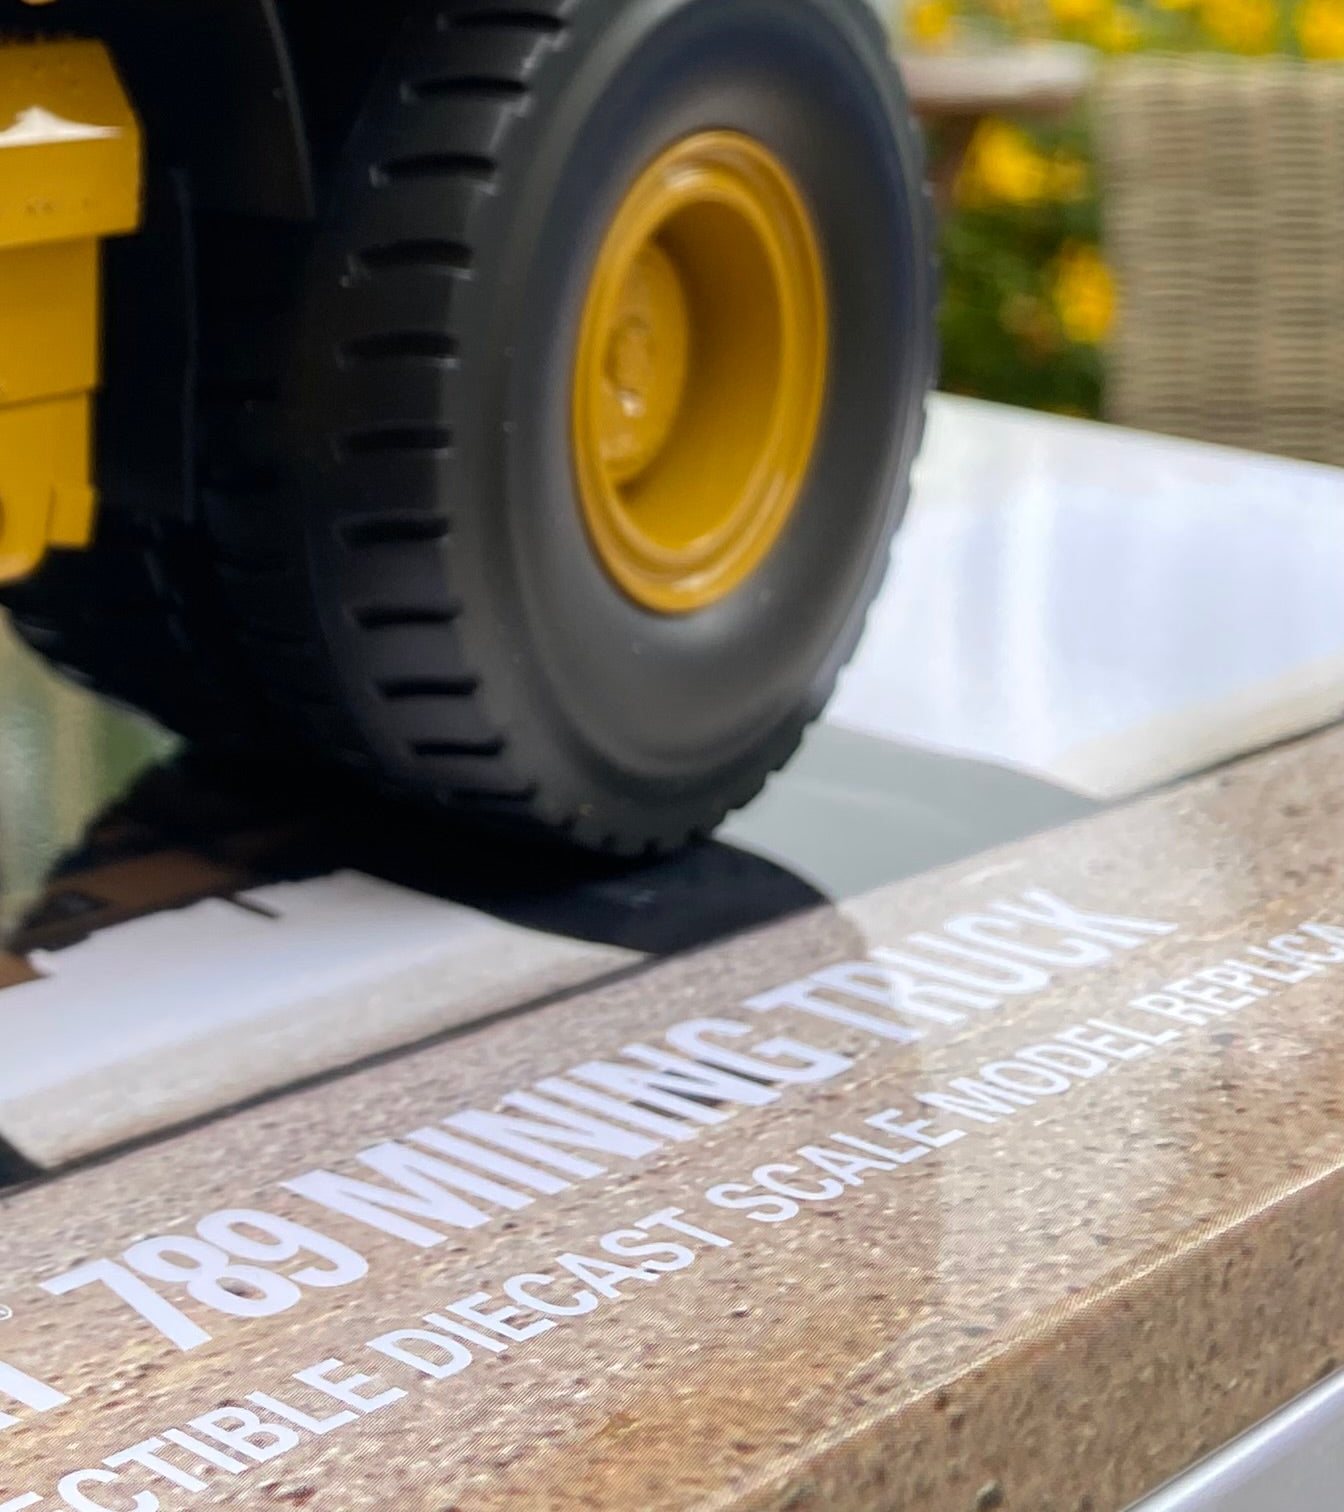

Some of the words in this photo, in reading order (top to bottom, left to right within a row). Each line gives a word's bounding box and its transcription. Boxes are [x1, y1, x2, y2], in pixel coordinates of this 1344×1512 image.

[40, 1208, 368, 1350] 789
[280, 1018, 854, 1248] MINING
[742, 888, 1179, 1044] TRUCK
[366, 1206, 732, 1380] DIECAST
[705, 1107, 968, 1223] SCALE
[917, 1018, 1182, 1124] MODEL
